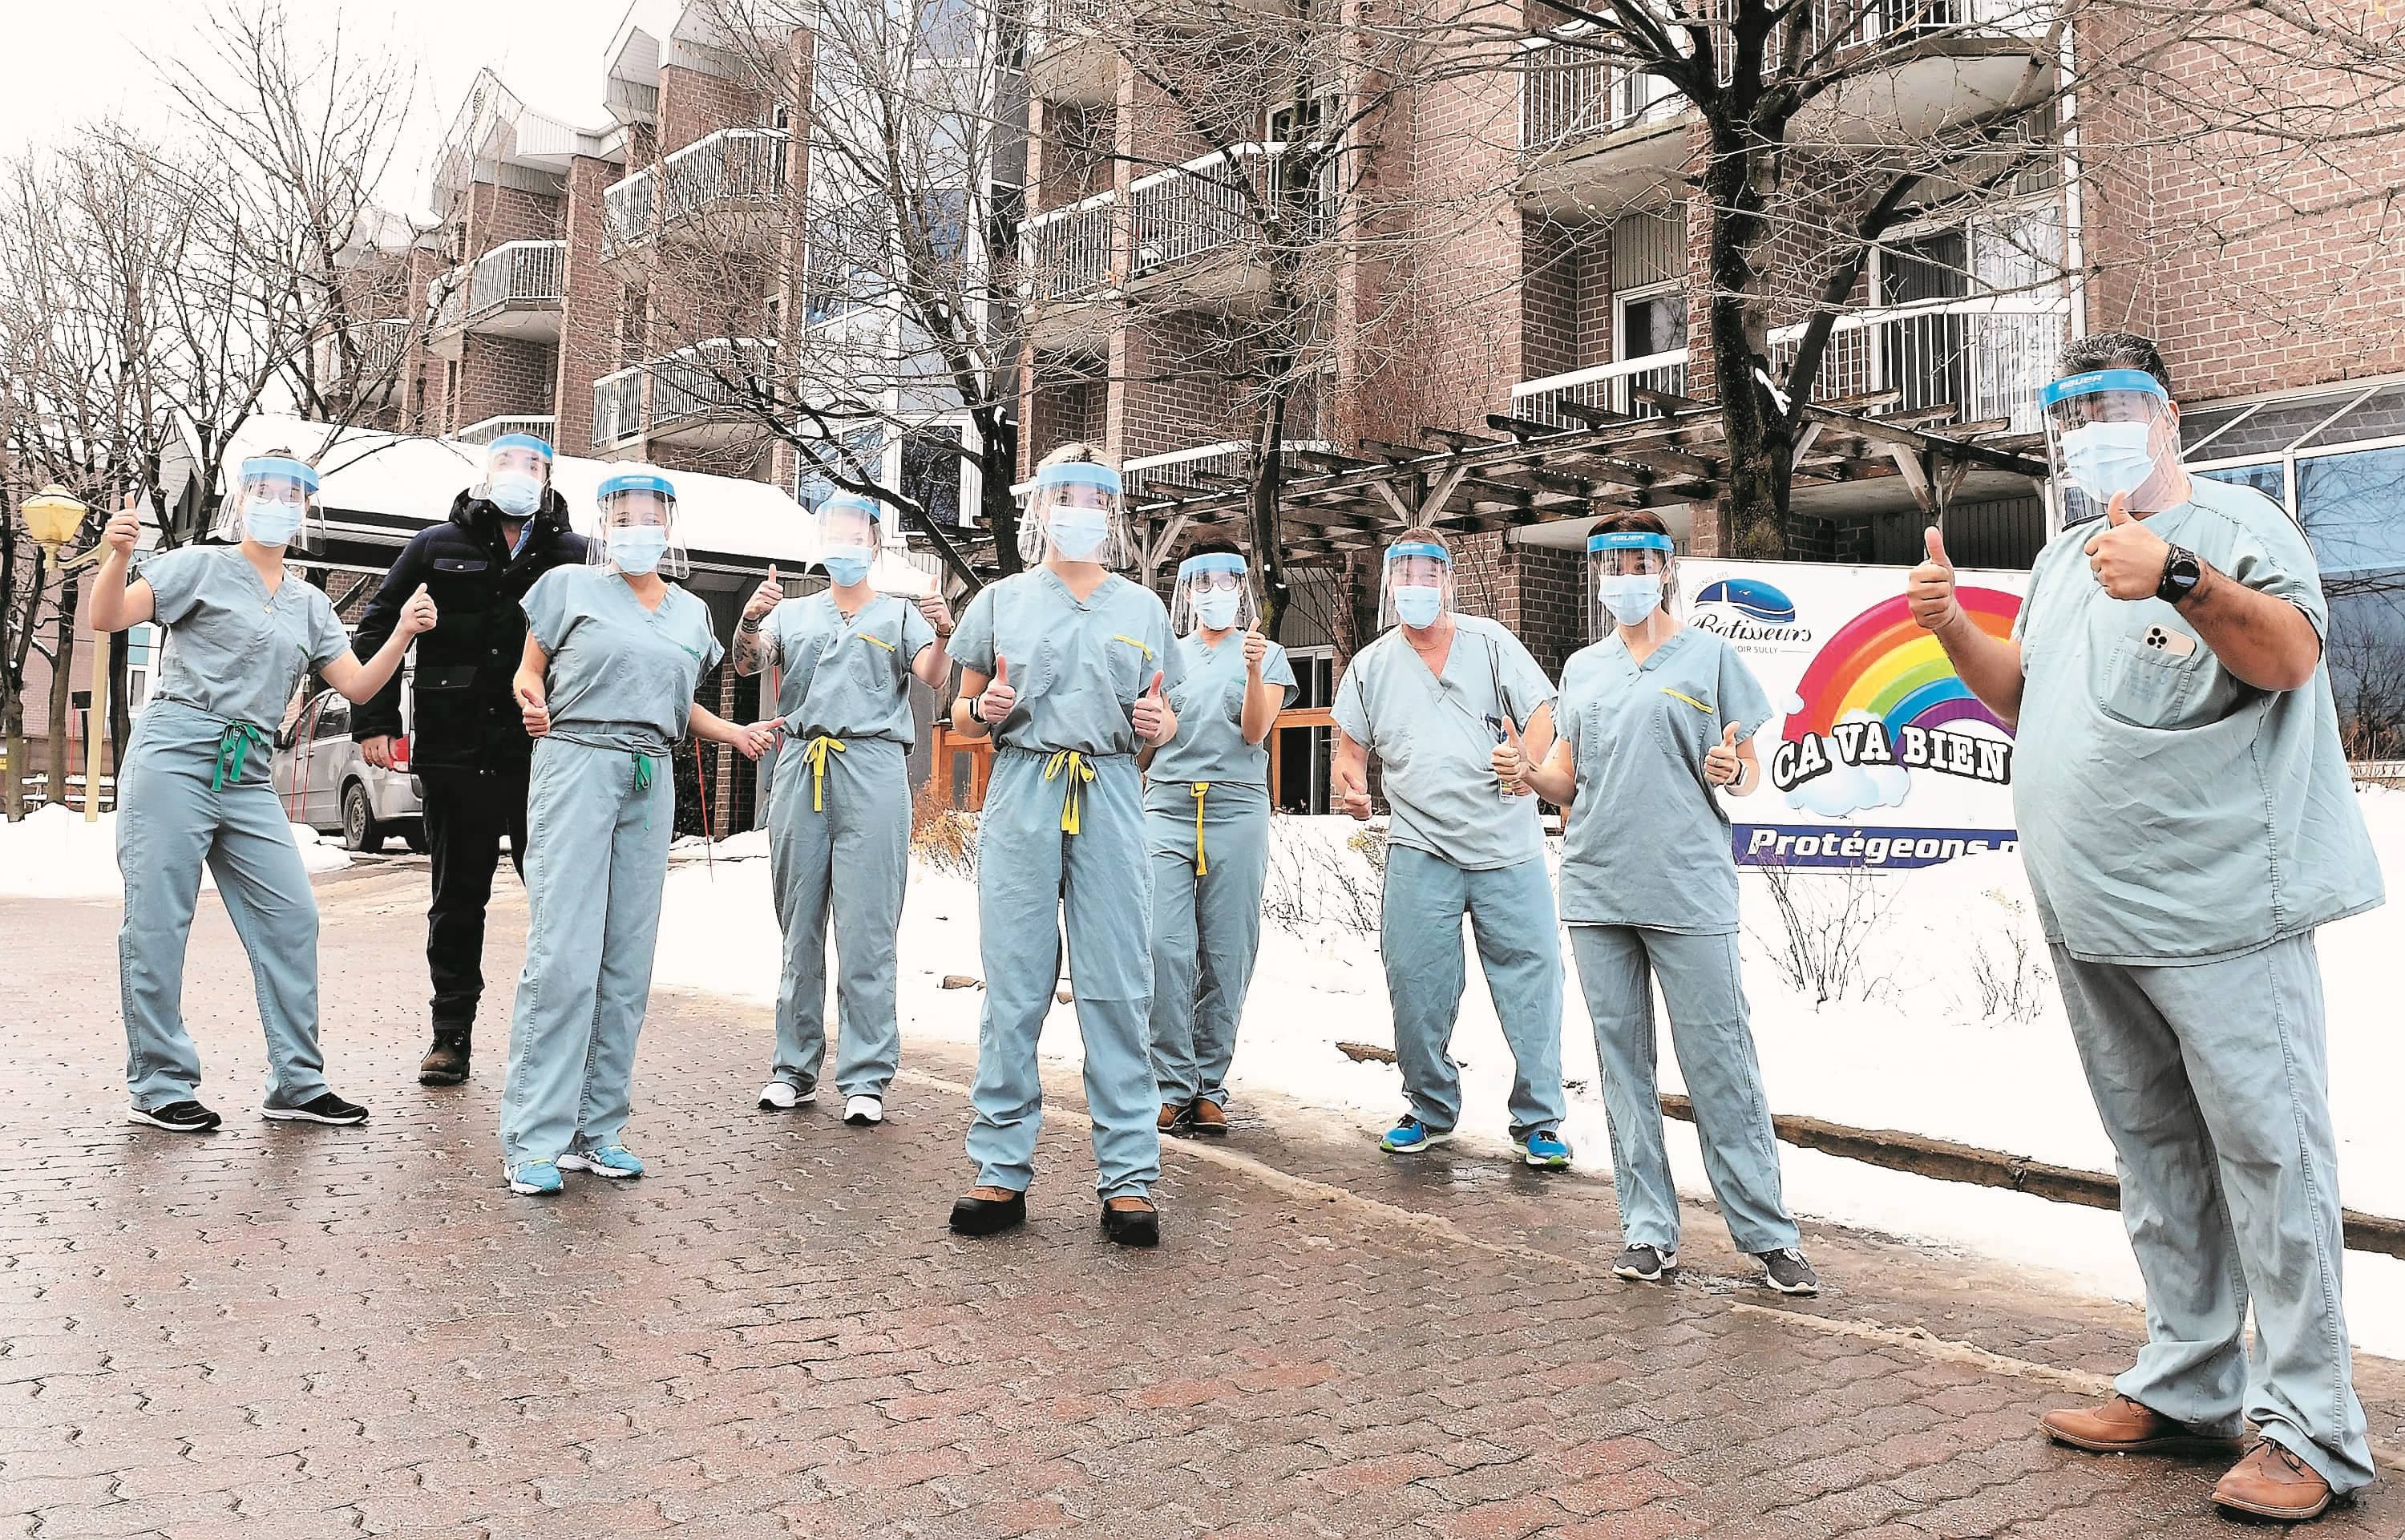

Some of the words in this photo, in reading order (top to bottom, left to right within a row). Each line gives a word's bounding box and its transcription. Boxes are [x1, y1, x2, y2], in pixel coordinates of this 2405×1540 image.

[1753, 645, 1778, 654] SULLY
[1833, 721, 1891, 766] VA
[1901, 724, 2013, 785] BIEN
[1746, 827, 1990, 865] Protégeons
